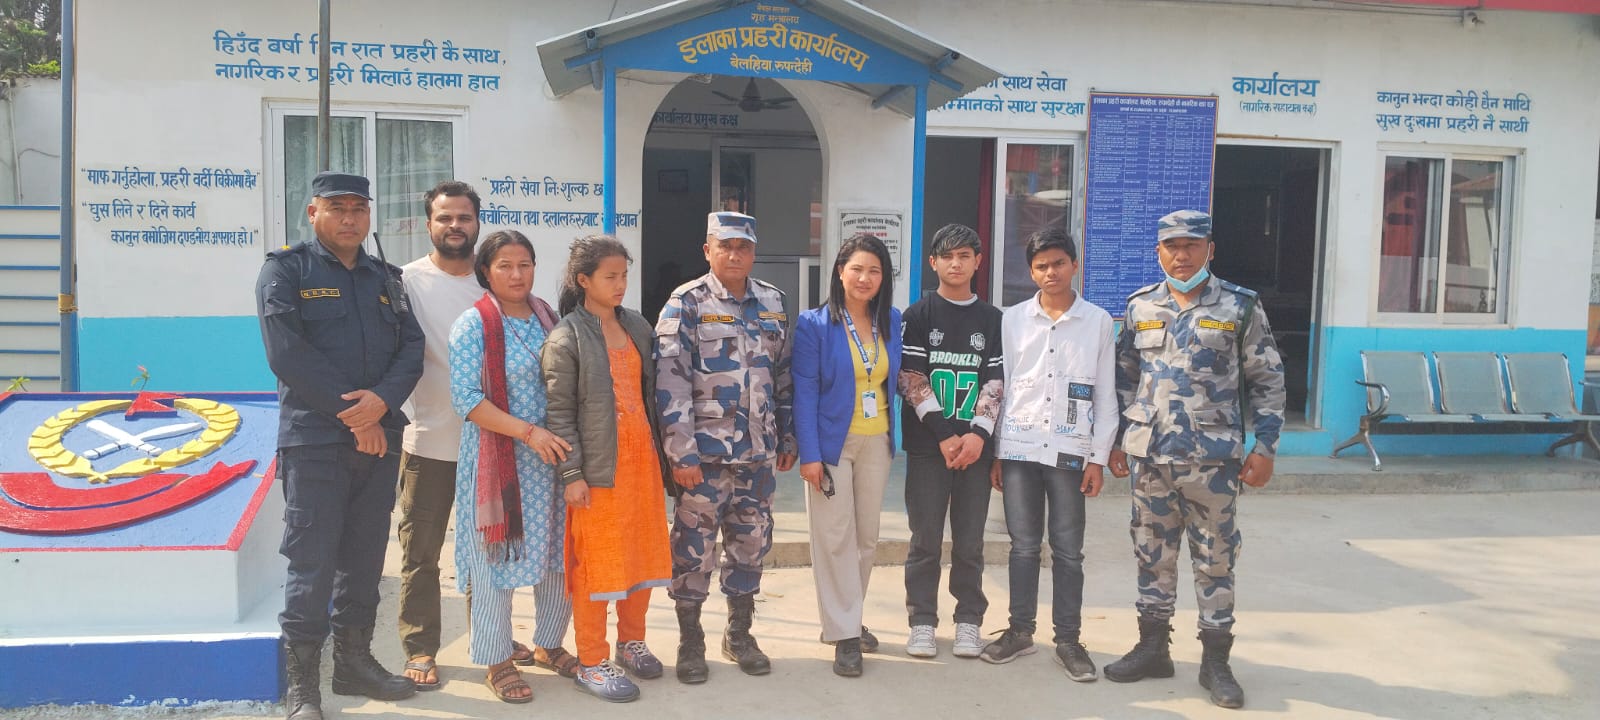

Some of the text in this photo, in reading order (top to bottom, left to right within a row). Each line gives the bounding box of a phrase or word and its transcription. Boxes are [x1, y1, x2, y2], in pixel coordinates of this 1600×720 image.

[213, 30, 262, 55] हिउँद
[310, 33, 348, 57] िन
[351, 42, 385, 60] रात
[390, 38, 438, 62] प्रहरी
[441, 40, 460, 62] कै
[677, 23, 869, 72] इलाका प्रहरी कार्यालय
[215, 58, 284, 82] नागरिक
[288, 64, 301, 83] र
[416, 71, 463, 91] हातमा
[467, 74, 500, 92] हात
[1002, 76, 1033, 91] साथ
[1036, 71, 1068, 92] सेवा
[1232, 71, 1320, 97] कार्यालय
[1007, 100, 1038, 114] साथ
[1041, 101, 1086, 118] सुरक्षा
[1412, 92, 1443, 109] भन्दा
[1446, 89, 1479, 112] कोही
[1503, 92, 1532, 112] माथि
[694, 113, 717, 129] प्रमुख
[719, 113, 738, 129] कक्ष
[1376, 113, 1402, 131] सुख
[1446, 114, 1480, 134] प्रहरी
[1483, 113, 1496, 131] नै
[1499, 116, 1530, 134] साथी
[160, 167, 190, 190] प्रहरी
[193, 168, 213, 190] वर्दी
[520, 176, 541, 199] सेवा
[544, 176, 590, 202] निःशुल्क
[112, 198, 133, 219] लिने
[136, 203, 146, 220] र
[148, 199, 170, 220] दिने
[172, 201, 196, 219] कार्य
[524, 209, 540, 226] तथा
[929, 368, 979, 421] 07
